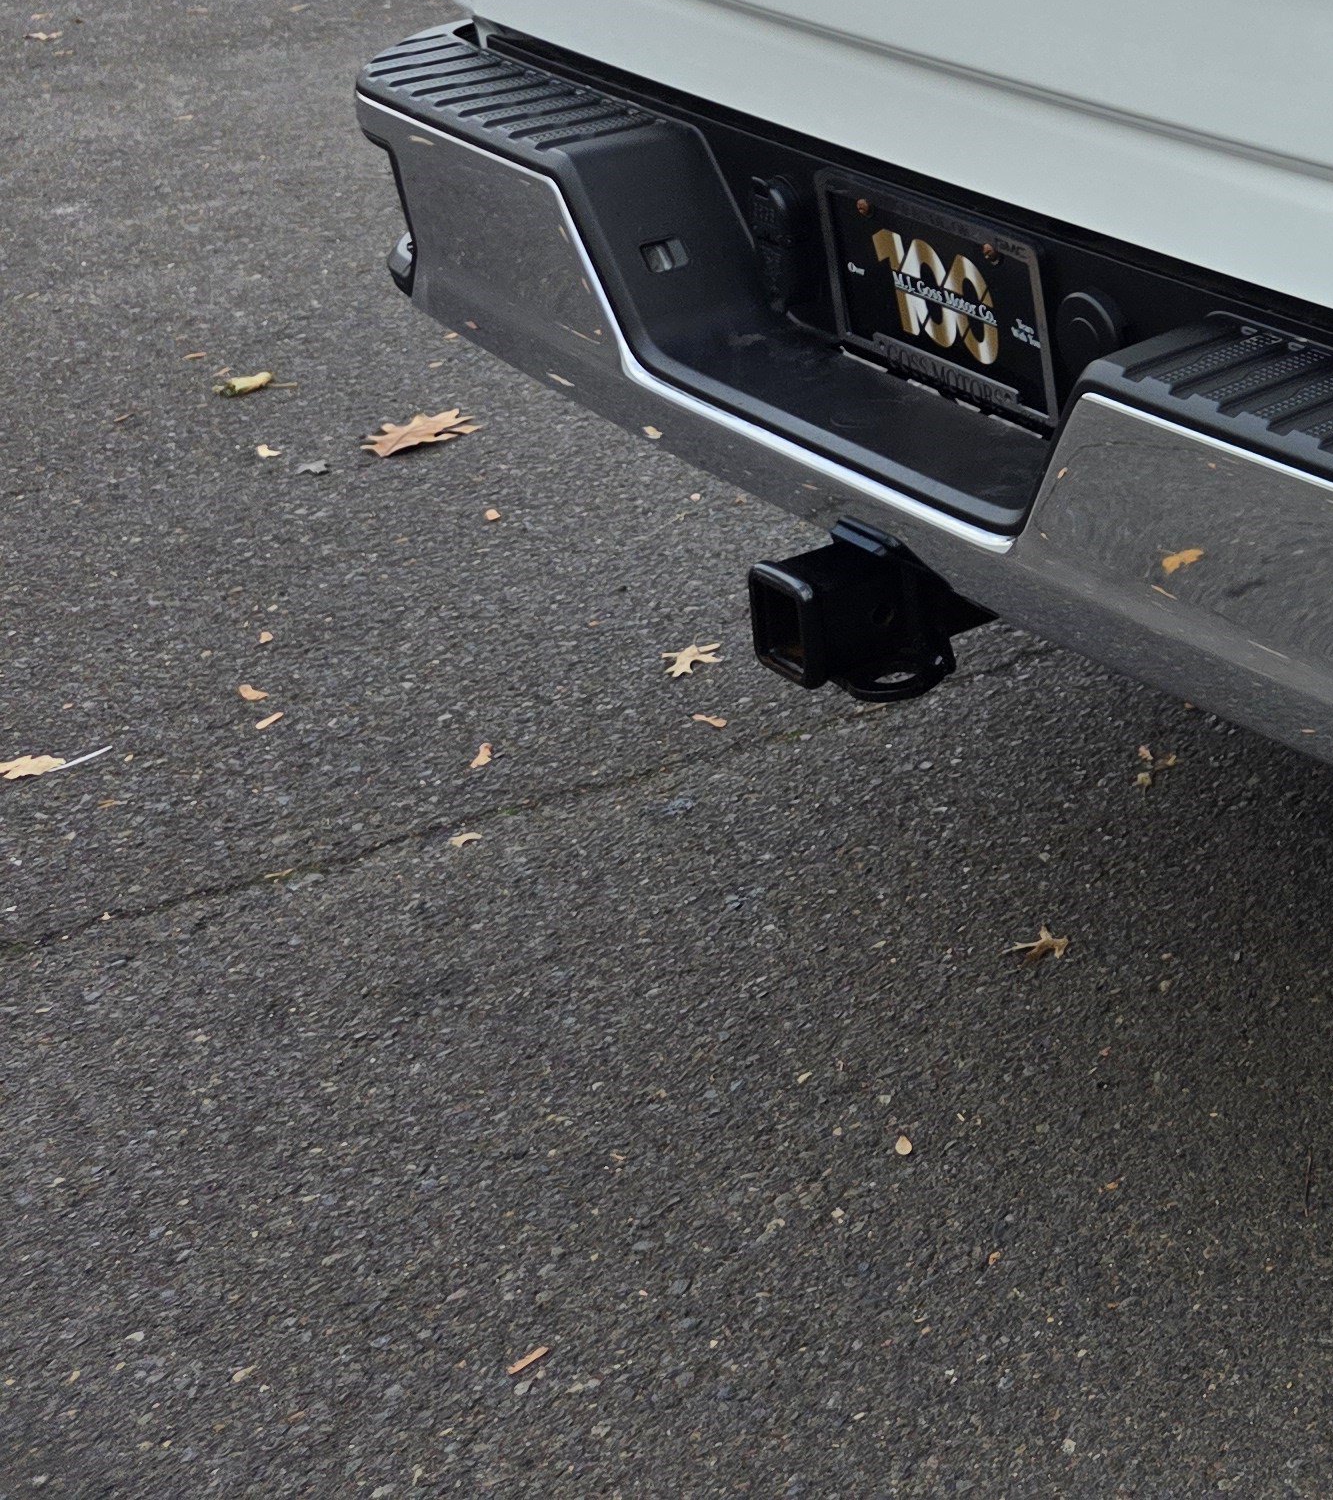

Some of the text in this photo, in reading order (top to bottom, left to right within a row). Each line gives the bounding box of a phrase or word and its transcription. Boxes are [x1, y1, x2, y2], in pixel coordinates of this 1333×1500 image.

[872, 228, 999, 365] 100
[916, 280, 943, 302] Goss
[943, 289, 977, 316] Motor
[977, 303, 998, 326] Co.
